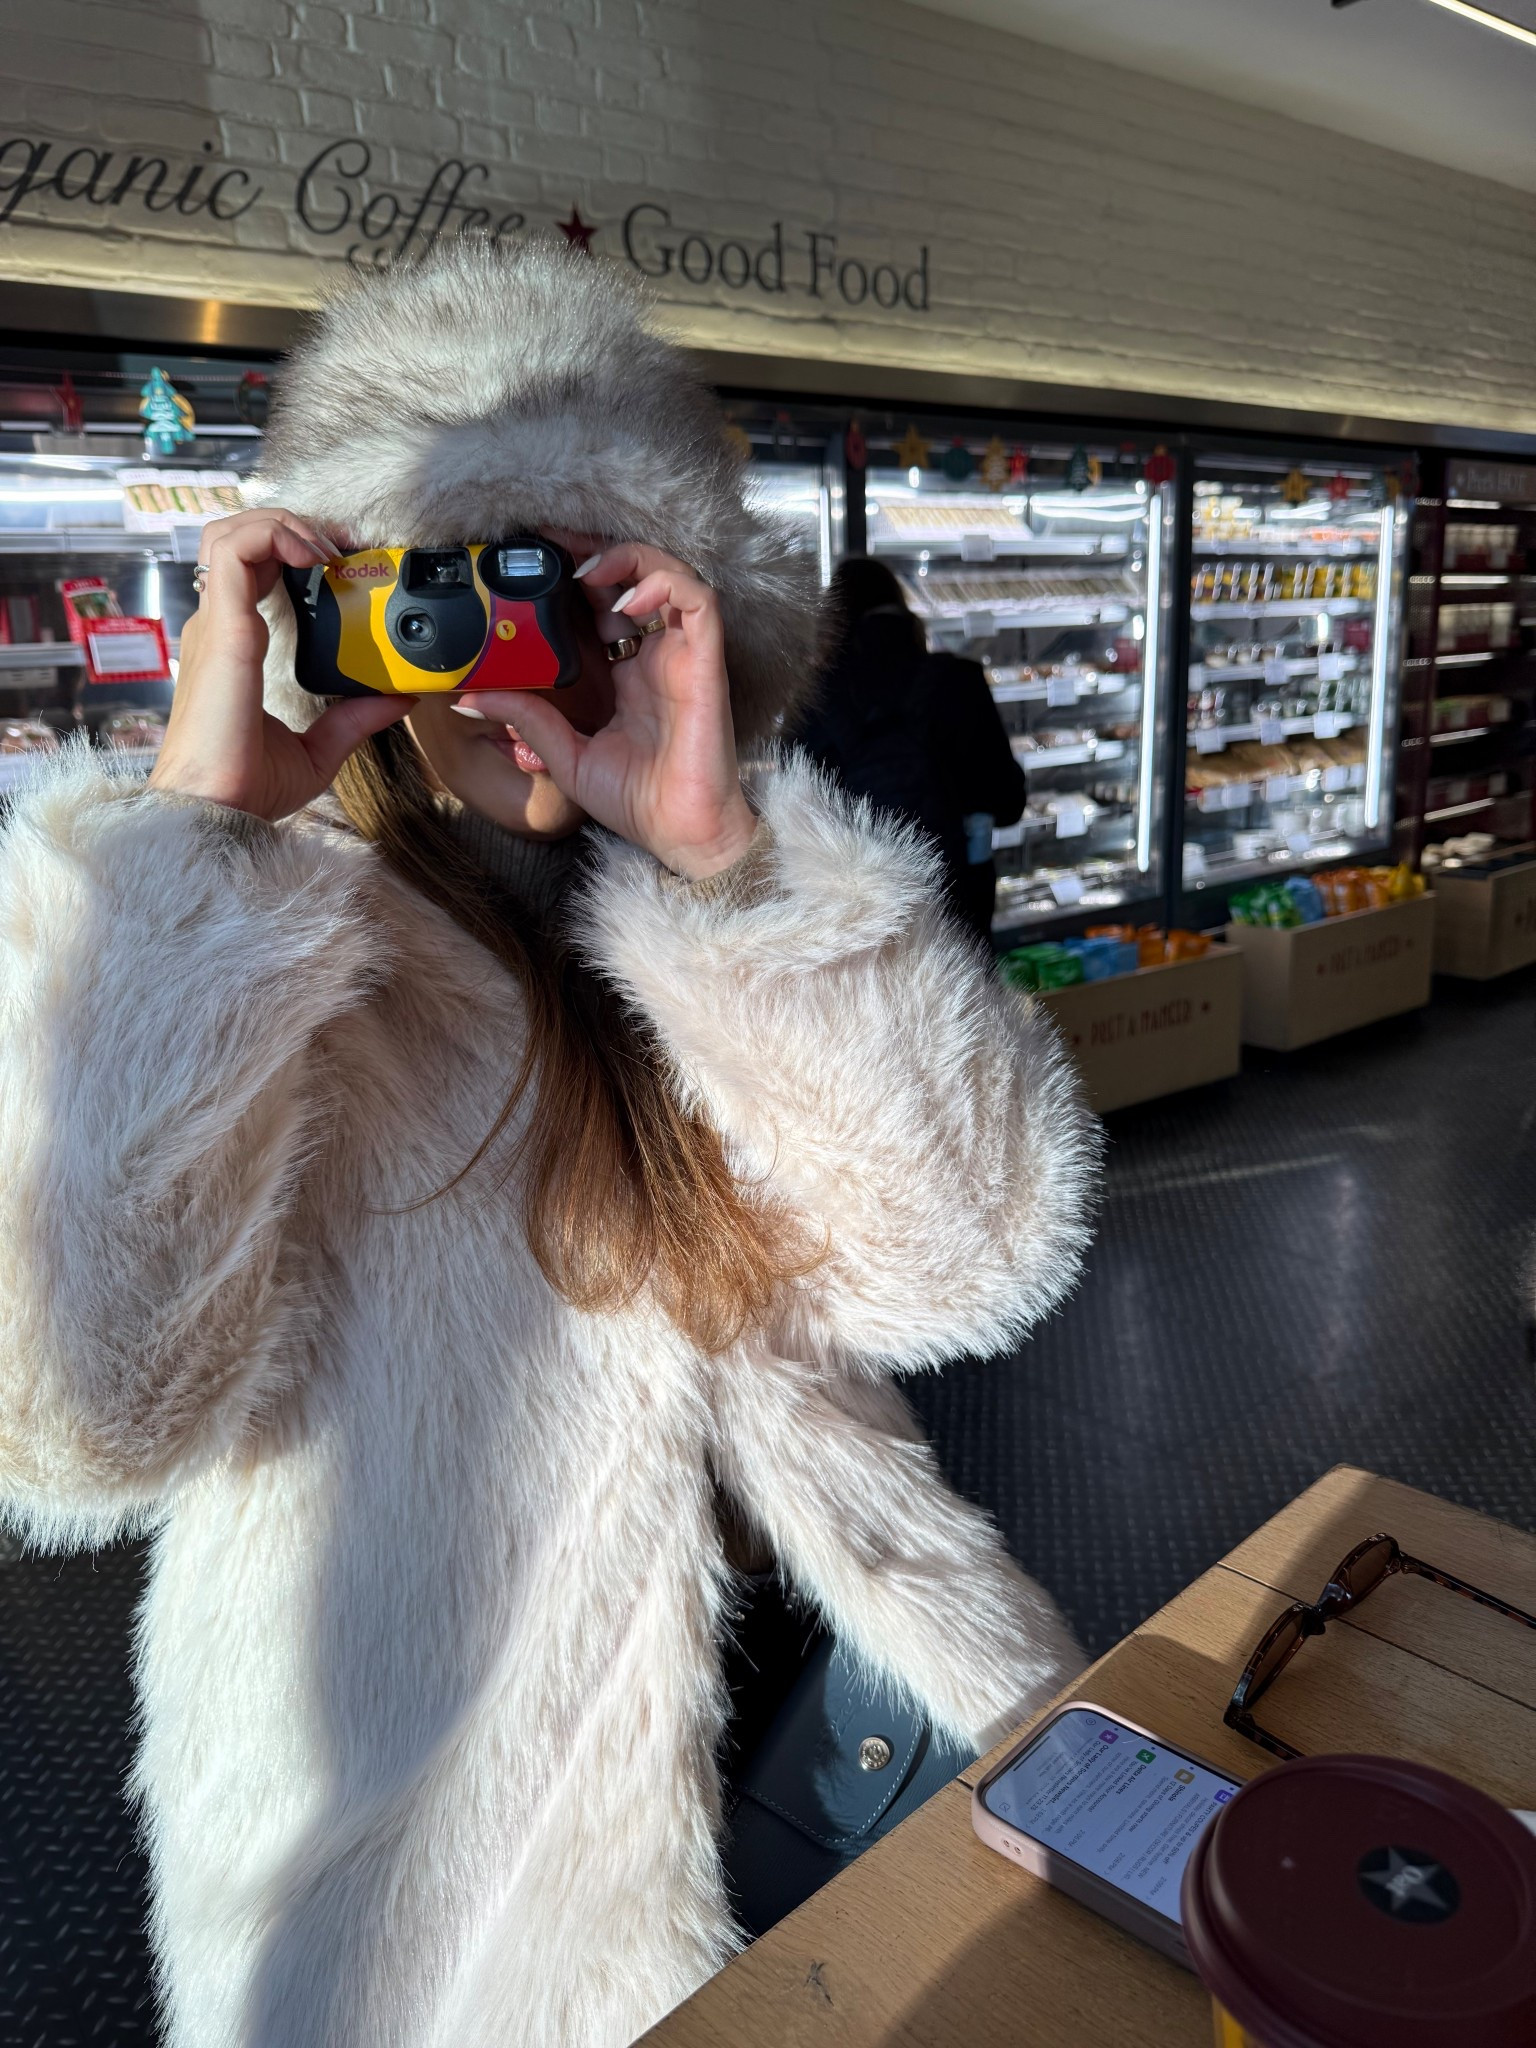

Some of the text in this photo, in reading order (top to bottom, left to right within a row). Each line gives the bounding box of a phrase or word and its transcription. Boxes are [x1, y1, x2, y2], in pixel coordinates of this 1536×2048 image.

[621, 204, 785, 293] Good
[804, 230, 931, 311] Food
[334, 562, 390, 580] Kodak
[1086, 1750, 1102, 1764] Lady
[1097, 1743, 1110, 1753] Our
[1167, 1784, 1186, 1802] Shinola
